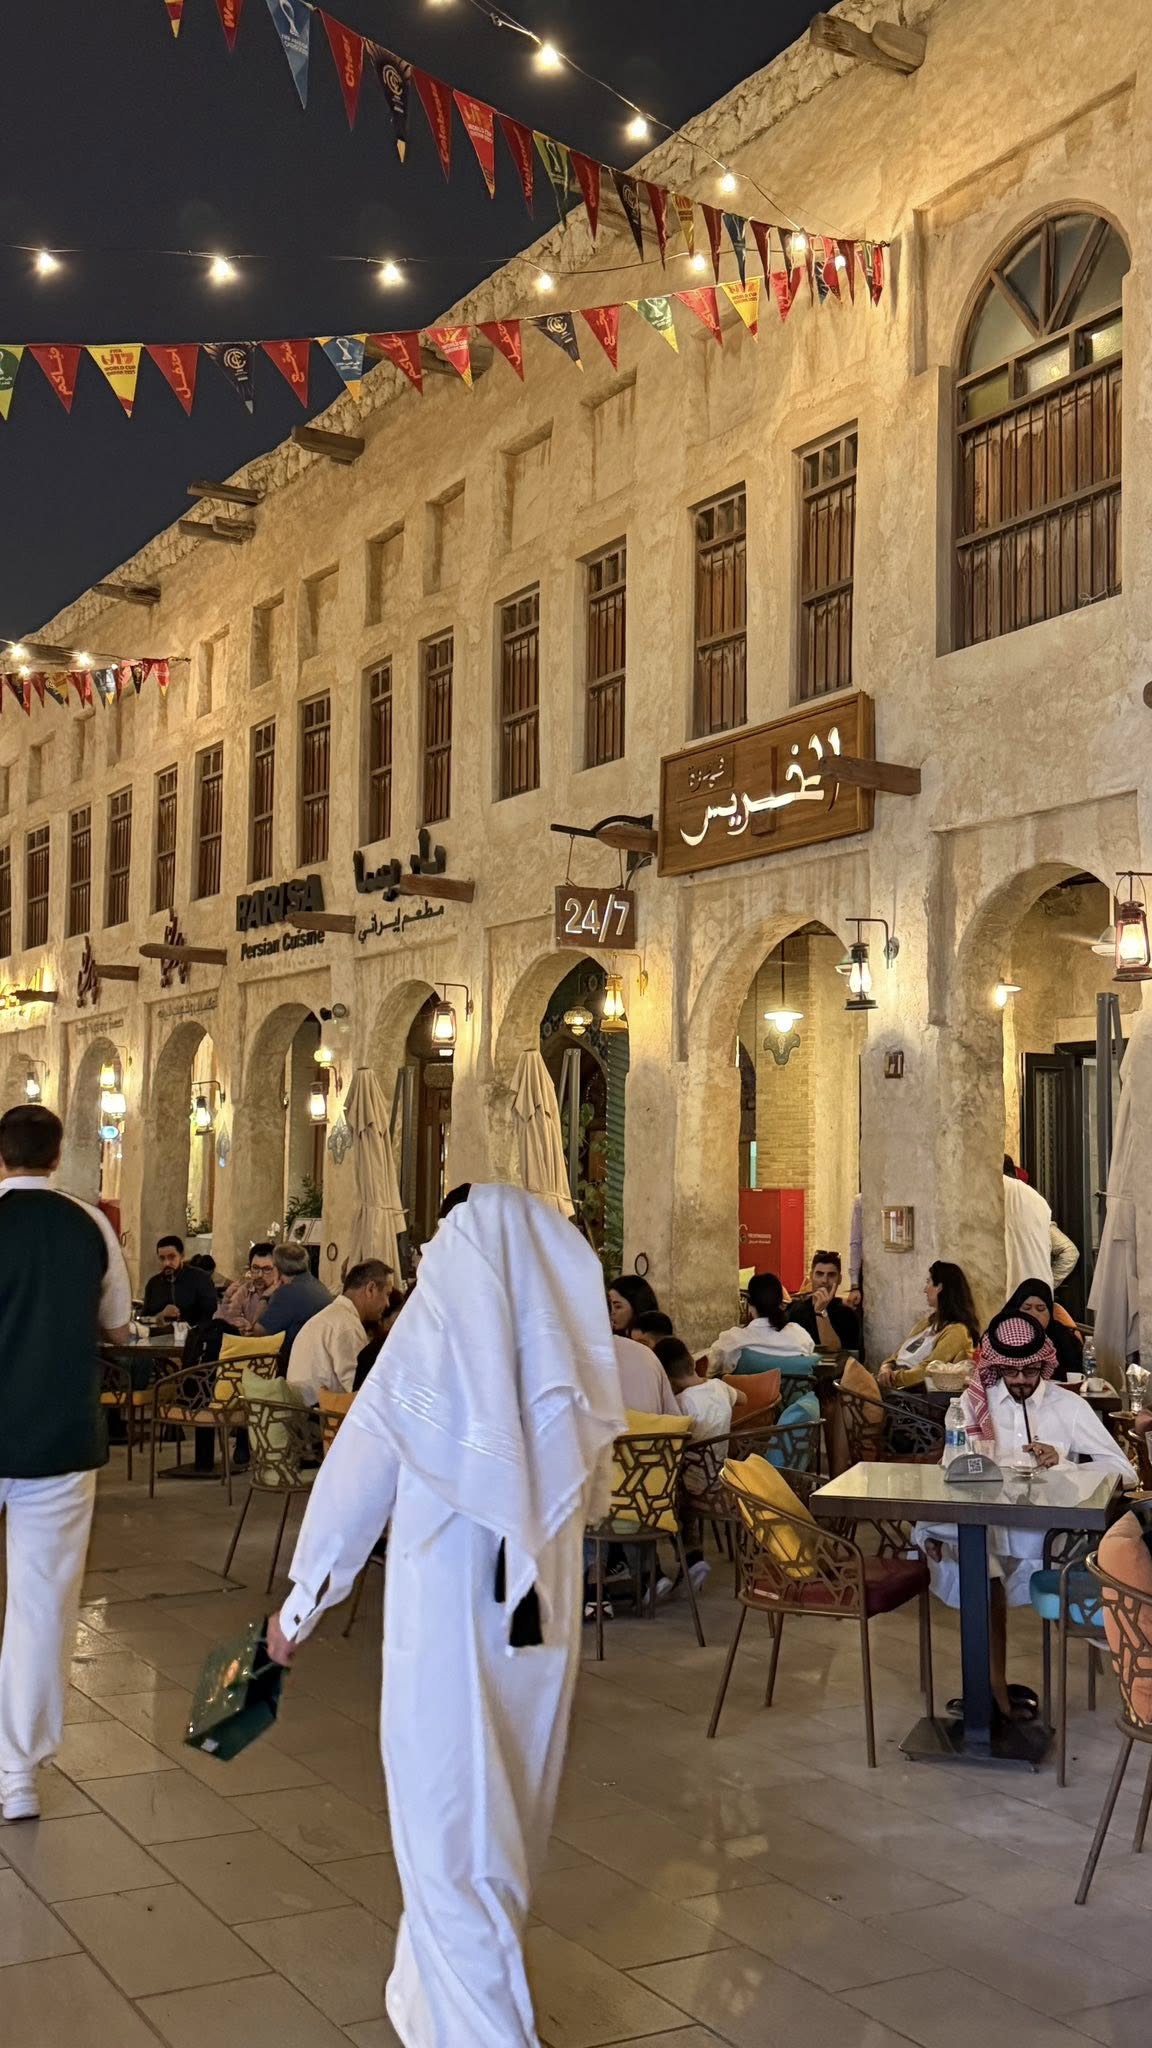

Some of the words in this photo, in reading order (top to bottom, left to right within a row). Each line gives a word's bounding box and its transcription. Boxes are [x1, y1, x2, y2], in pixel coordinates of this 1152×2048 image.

[342, 35, 355, 87] Cheer
[236, 873, 325, 932] PARISA
[402, 899, 445, 933] مطعم
[564, 893, 630, 943] 24/7
[241, 937, 280, 962] Persian
[282, 929, 326, 951] Cuisine
